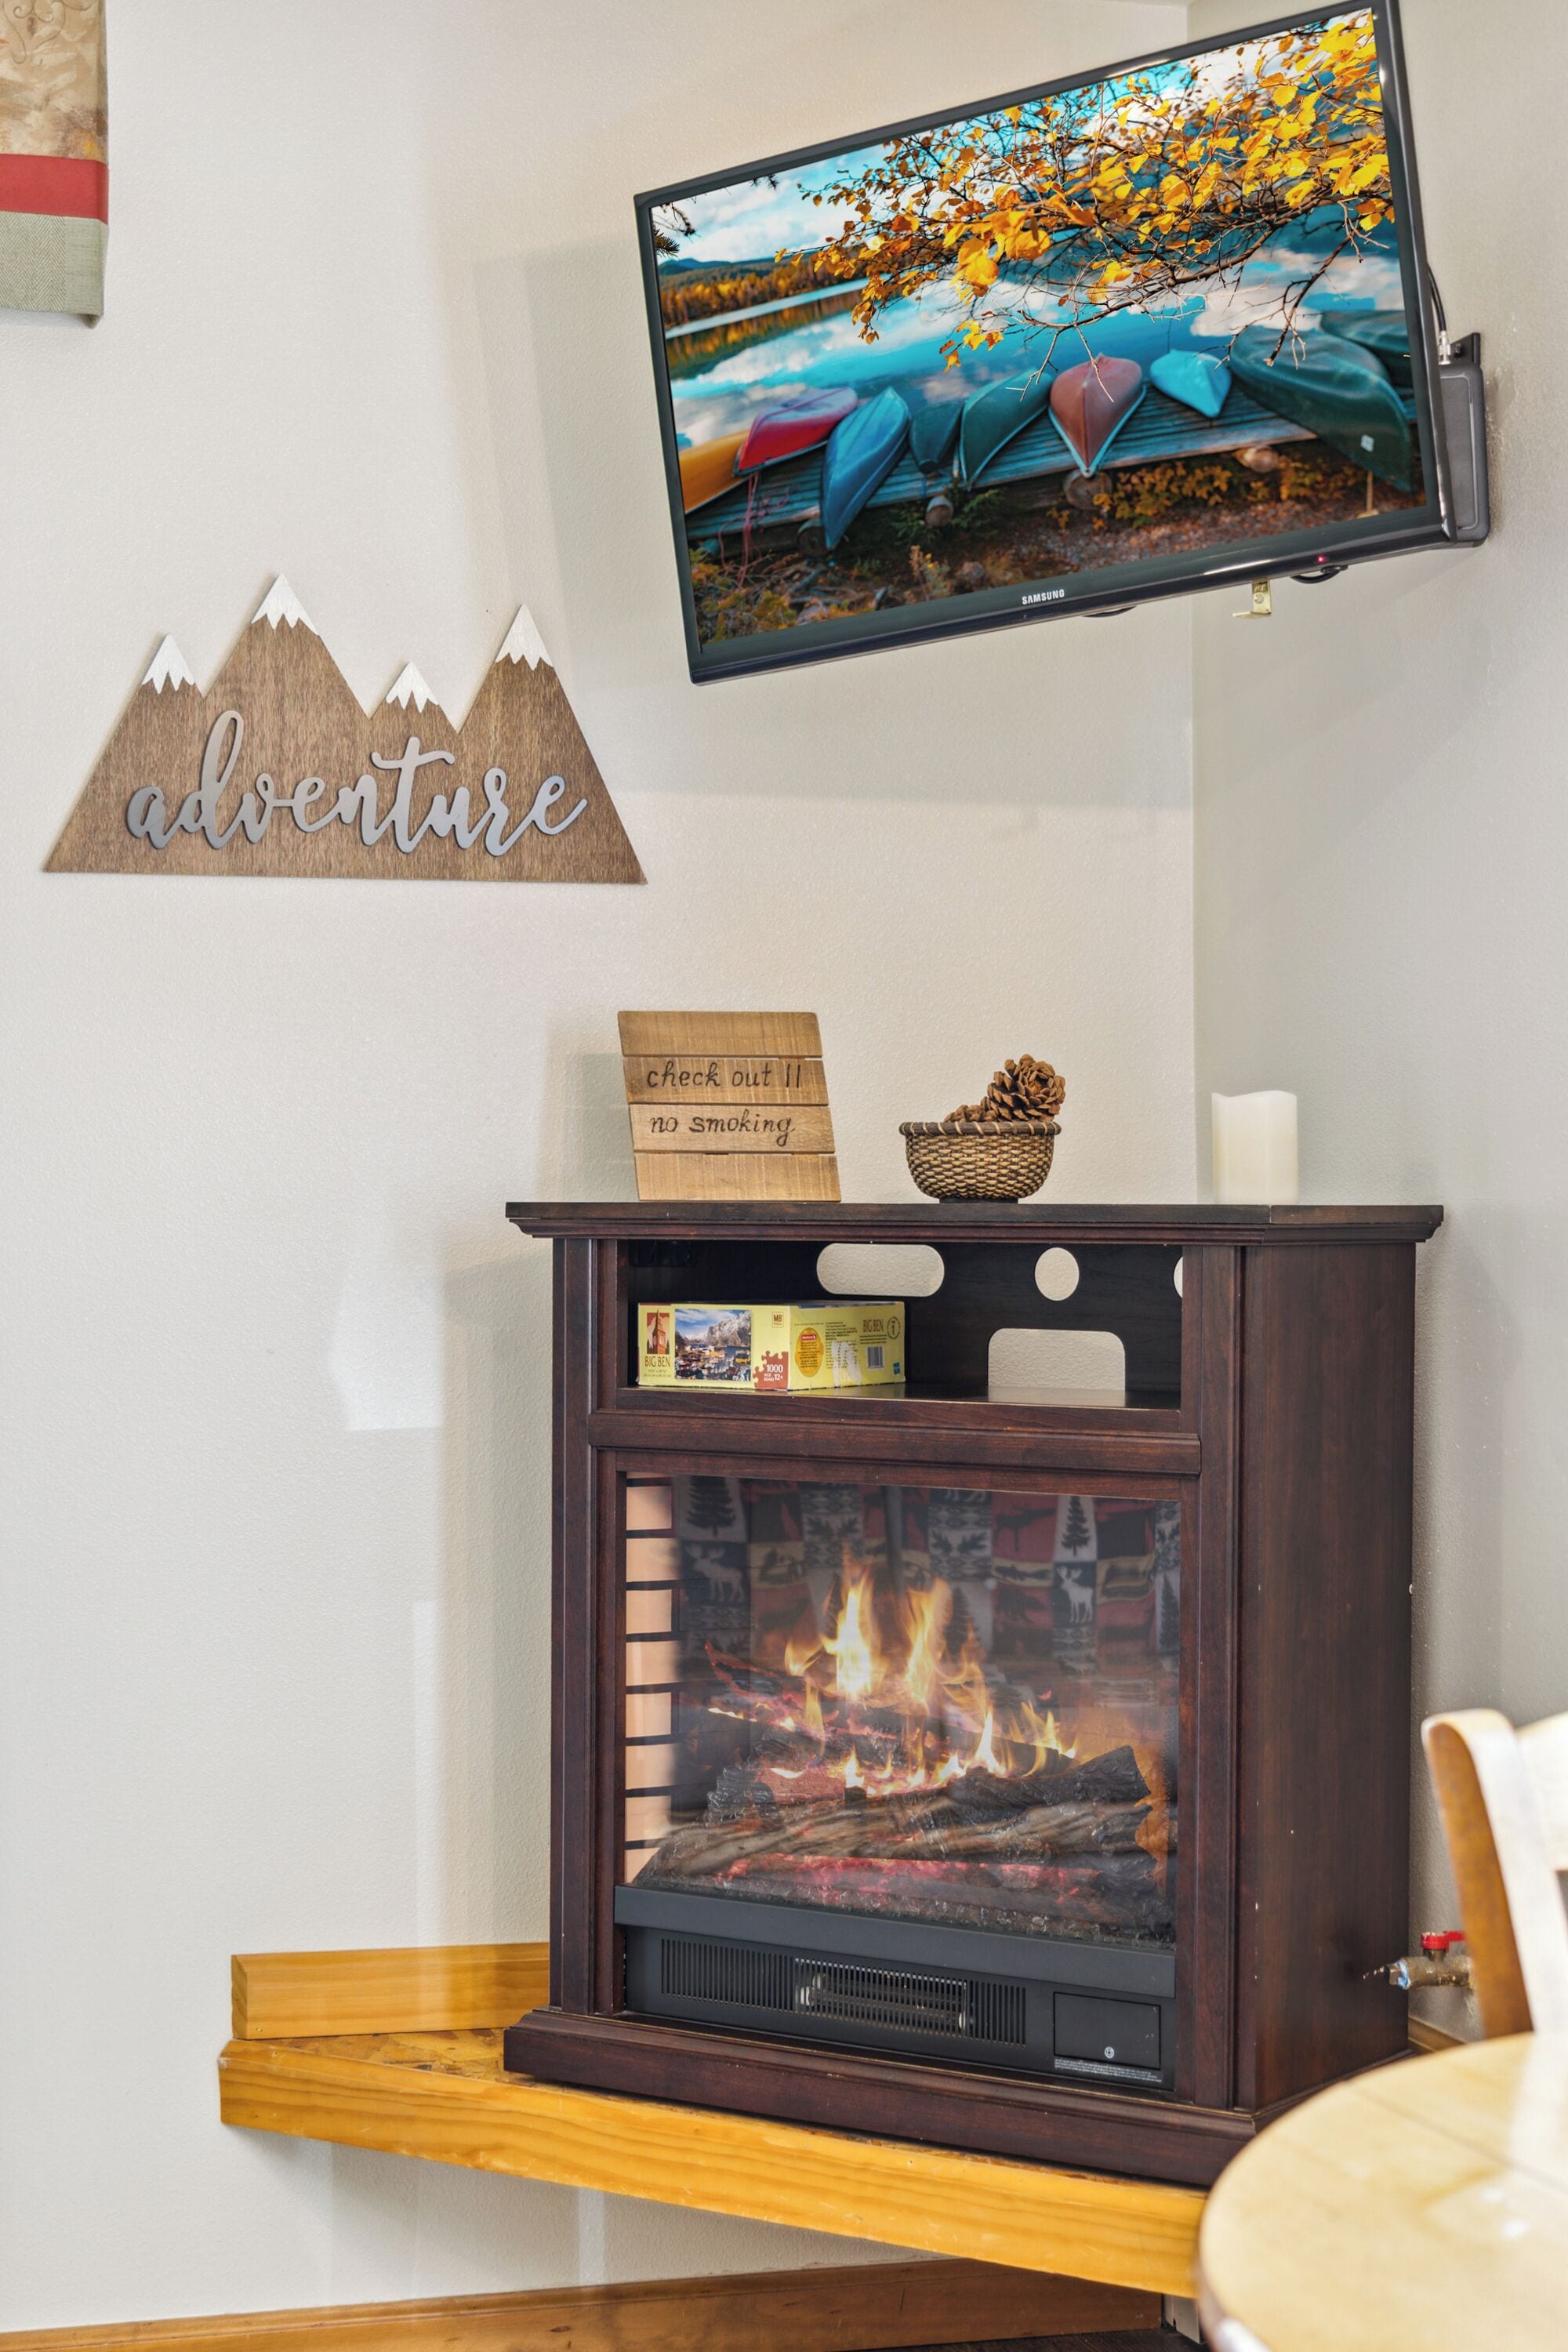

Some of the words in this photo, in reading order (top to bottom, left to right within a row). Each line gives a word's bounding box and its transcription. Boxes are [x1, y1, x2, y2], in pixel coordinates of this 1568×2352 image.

[1022, 589, 1065, 605] SAMSUNG
[125, 710, 588, 857] adventure
[647, 1060, 720, 1087] check
[731, 1062, 772, 1087] out
[786, 1064, 801, 1089] 11
[650, 1116, 679, 1133] no
[688, 1109, 796, 1147] smoking
[863, 1319, 872, 1332] BIG
[873, 1319, 884, 1332] BEN
[644, 1356, 656, 1367] BIG
[658, 1356, 671, 1367] BEN
[766, 1363, 783, 1373] 1000
